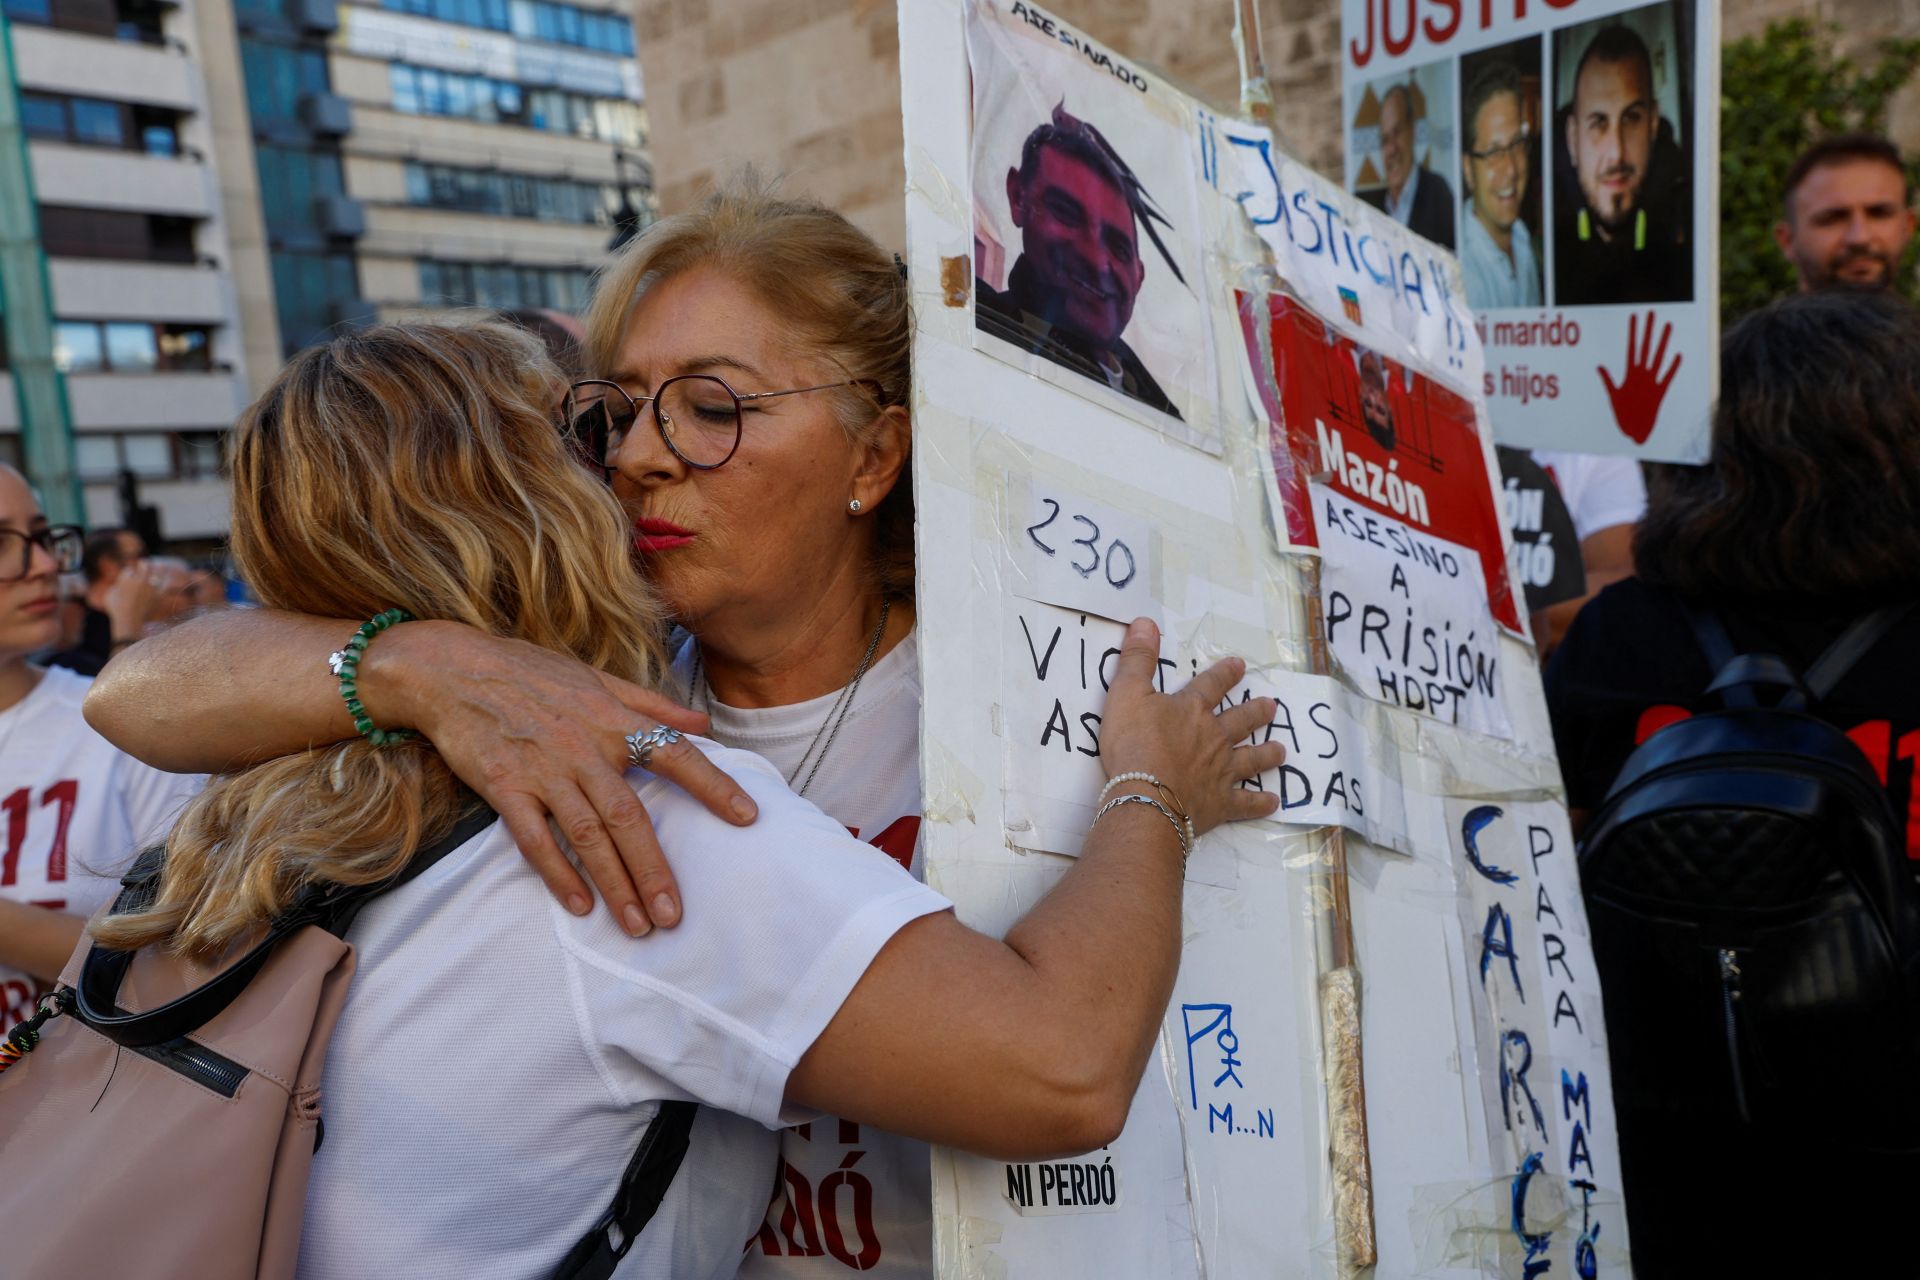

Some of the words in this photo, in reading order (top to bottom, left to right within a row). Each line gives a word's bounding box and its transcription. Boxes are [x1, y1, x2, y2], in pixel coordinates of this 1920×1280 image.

[1493, 312, 1581, 347] marido
[1501, 365, 1559, 405] hijos
[1315, 418, 1430, 526] Mazón
[1026, 498, 1136, 590] 230
[1391, 563, 1409, 599] A
[1376, 666, 1467, 724] HDPT
[1529, 824, 1582, 1034] PARA
[1209, 1102, 1273, 1138] M...N
[1006, 1164, 1033, 1206] NI
[1040, 1156, 1116, 1206] PERDÓ
